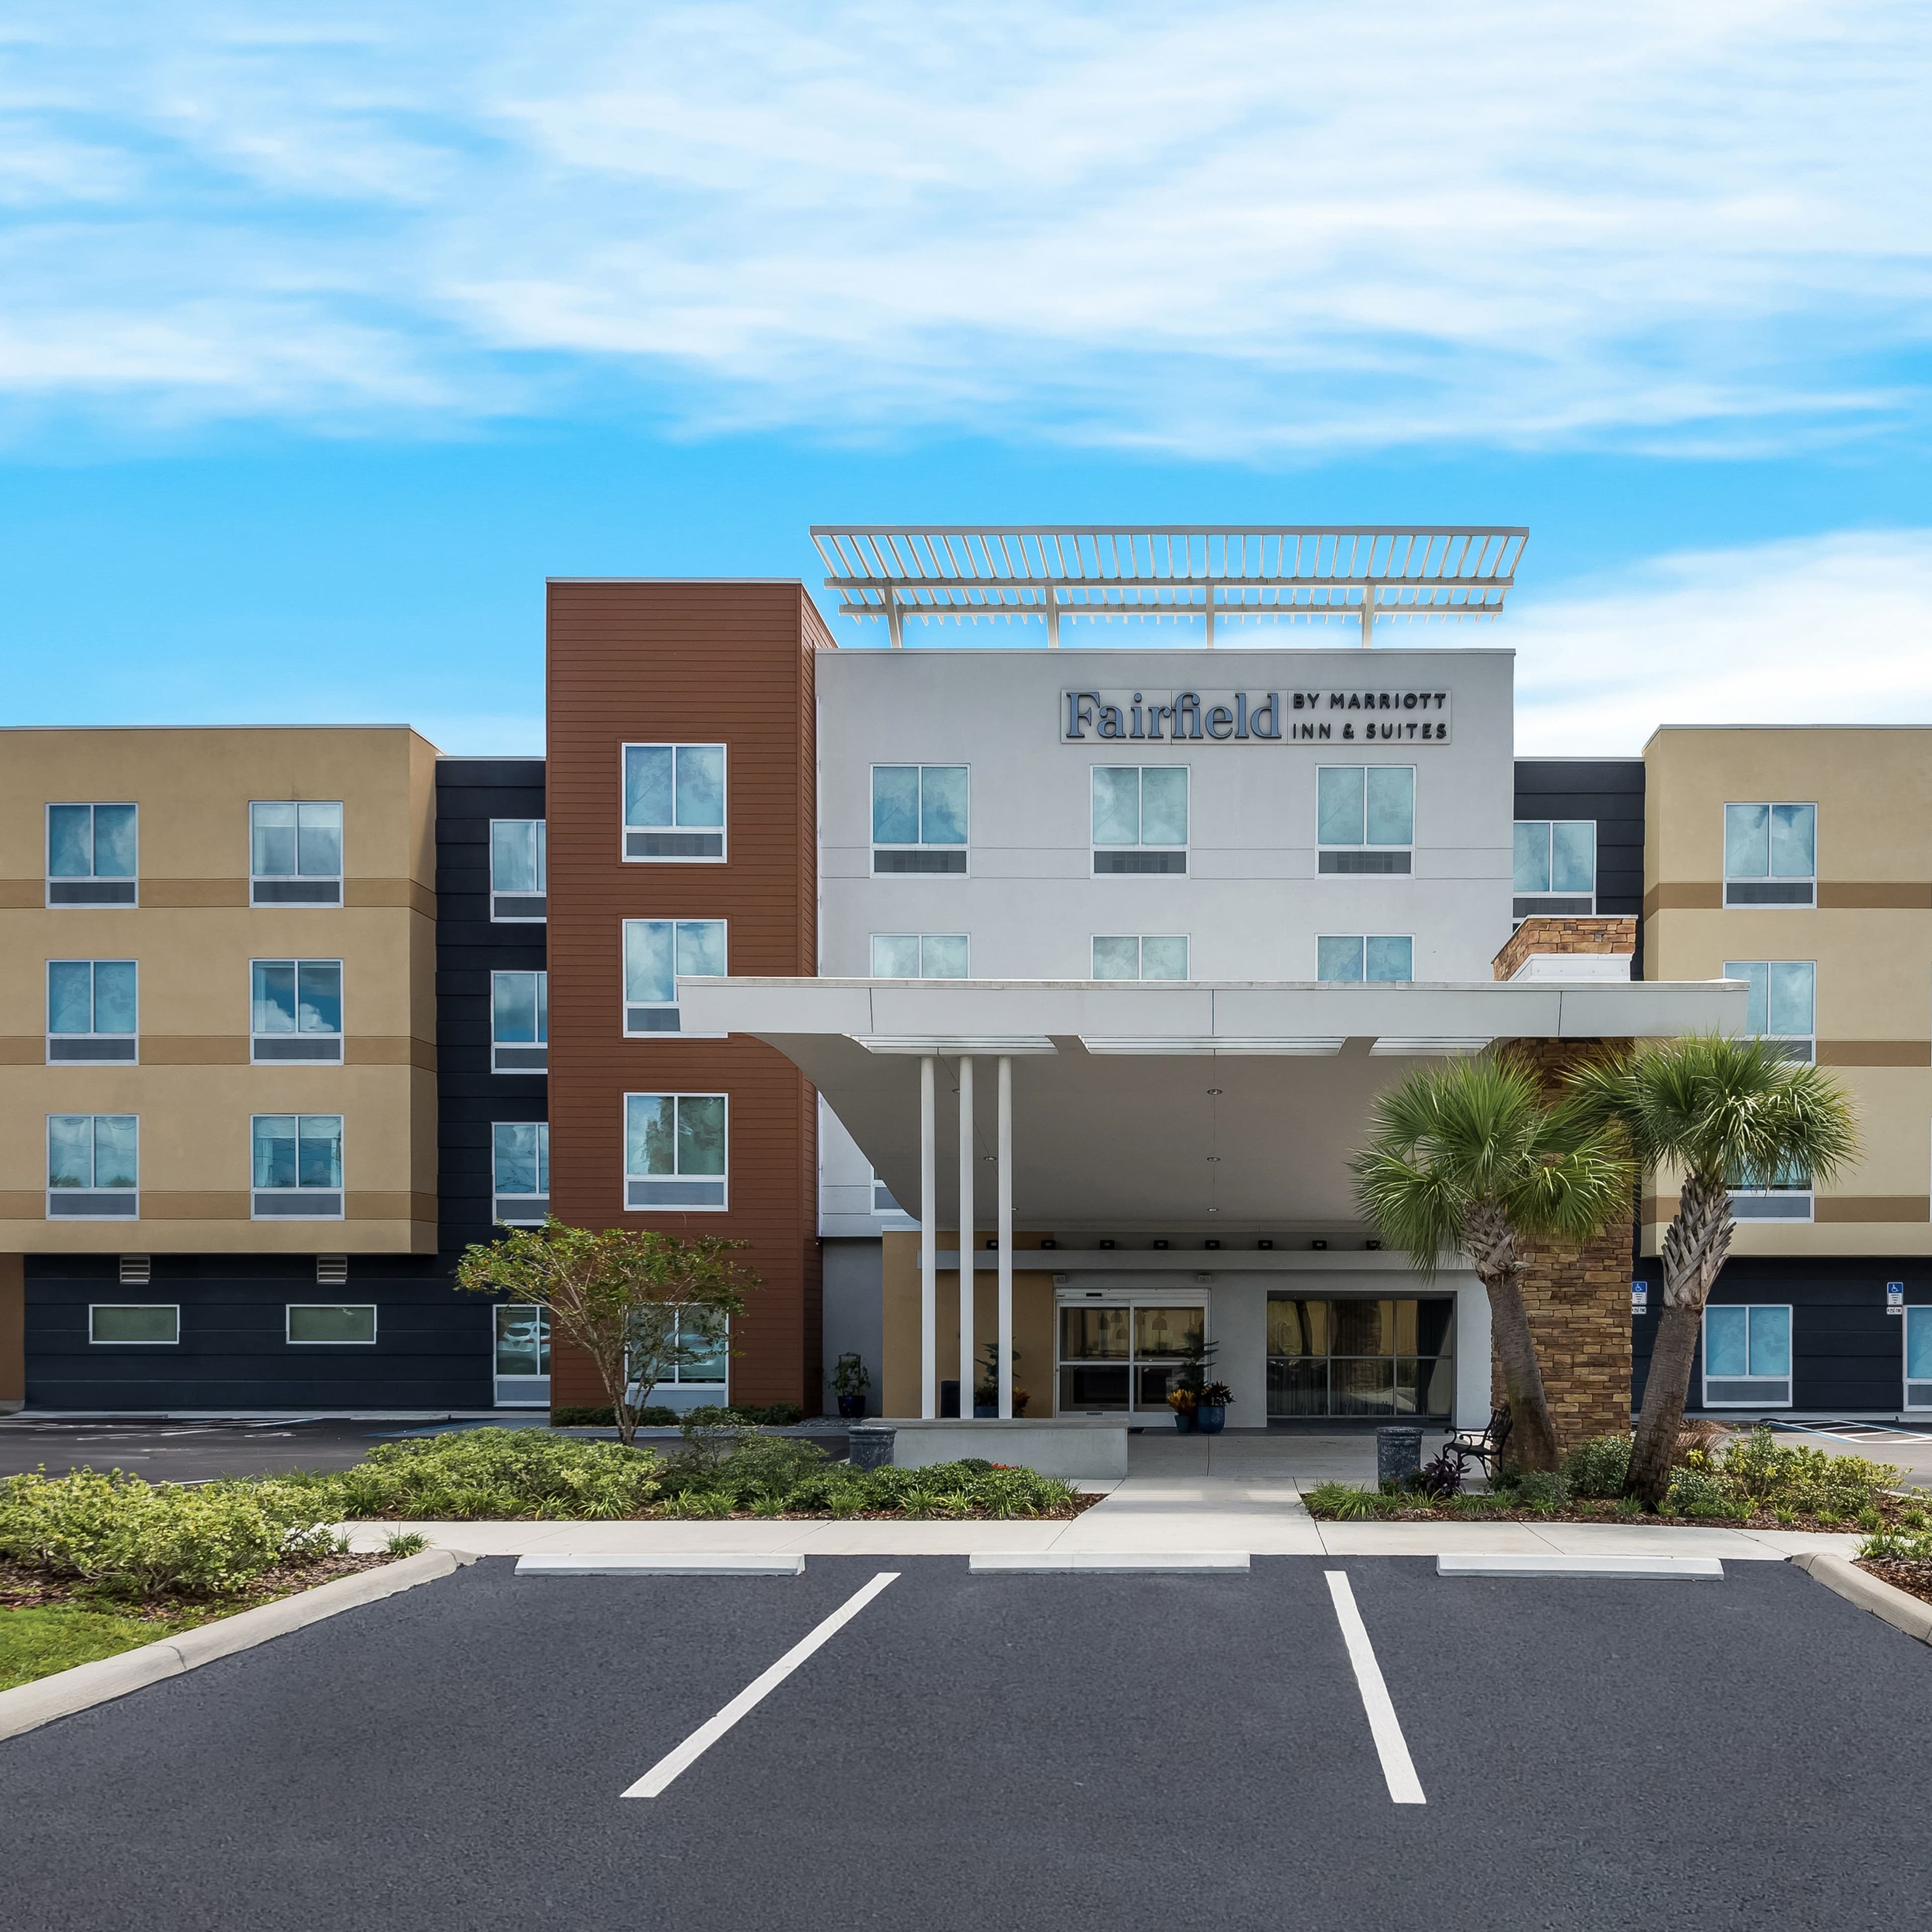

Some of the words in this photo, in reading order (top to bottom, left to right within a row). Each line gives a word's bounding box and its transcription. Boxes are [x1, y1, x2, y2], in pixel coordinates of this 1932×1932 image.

[1293, 693, 1320, 709] BY
[1330, 693, 1446, 709] MARRIOTT
[1066, 692, 1282, 739] Fairfield
[1293, 723, 1331, 739] INN
[1342, 723, 1354, 739] &
[1366, 723, 1447, 739] SUITES
